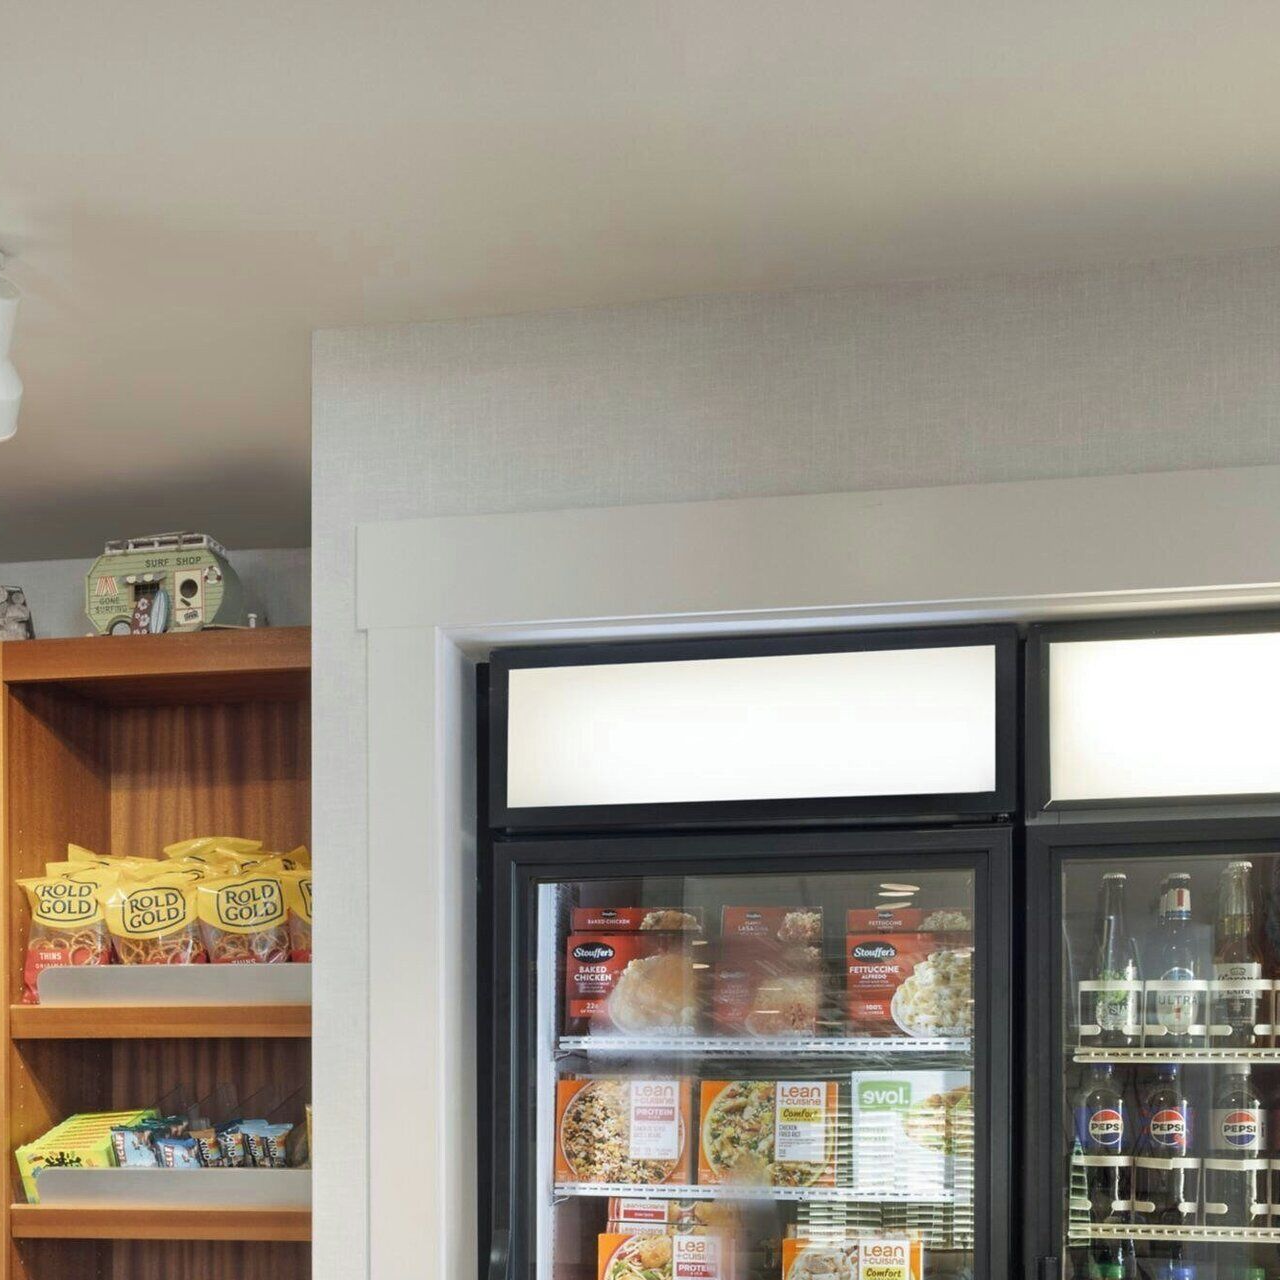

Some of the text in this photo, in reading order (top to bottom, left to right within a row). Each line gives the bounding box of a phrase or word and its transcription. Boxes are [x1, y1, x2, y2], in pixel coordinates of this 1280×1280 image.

[144, 556, 201, 568] SURF SHOP
[41, 883, 92, 899] ROLD
[225, 886, 274, 906] ROLD
[39, 900, 91, 915] GOLD
[130, 893, 178, 914] ROLD
[225, 900, 277, 920] GOLD
[129, 907, 179, 929] GOLD
[39, 952, 62, 960] THINS
[572, 946, 614, 959] Stouffer's
[853, 947, 896, 959] Stouffer's
[579, 966, 607, 974] BAKED
[849, 966, 900, 974] FETTUCCINE
[574, 974, 612, 982] CHICKEN
[1158, 995, 1200, 1006] ULTRA
[781, 1086, 822, 1098] Lean
[862, 1087, 909, 1105] evol.
[1152, 1122, 1185, 1132] PEPSI
[1223, 1124, 1257, 1134] PEPSI
[200, 1137, 211, 1161] KIND
[864, 1245, 905, 1257] Lean
[866, 1268, 902, 1278] Comfort
